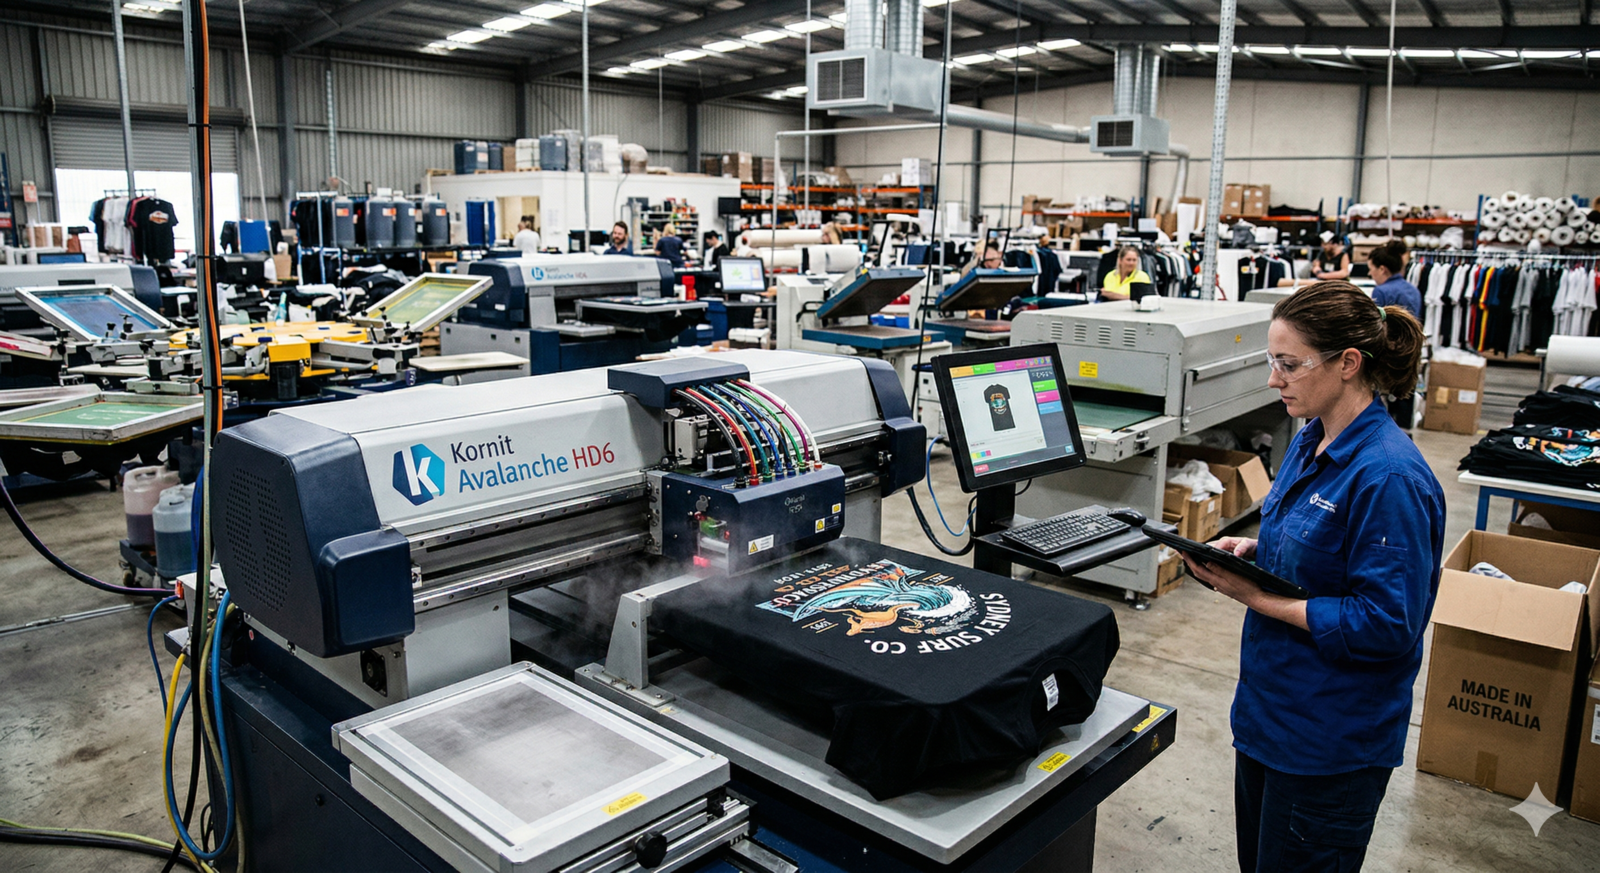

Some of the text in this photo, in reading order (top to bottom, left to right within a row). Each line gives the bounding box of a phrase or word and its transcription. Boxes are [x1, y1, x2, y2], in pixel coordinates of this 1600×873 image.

[450, 435, 515, 464] Kornit
[458, 442, 616, 493] Avalanche HD6
[864, 593, 1011, 654] SYDNEY SURF CO.
[1461, 679, 1532, 709] MADE IN
[1447, 695, 1541, 732] AUSTRALIA
